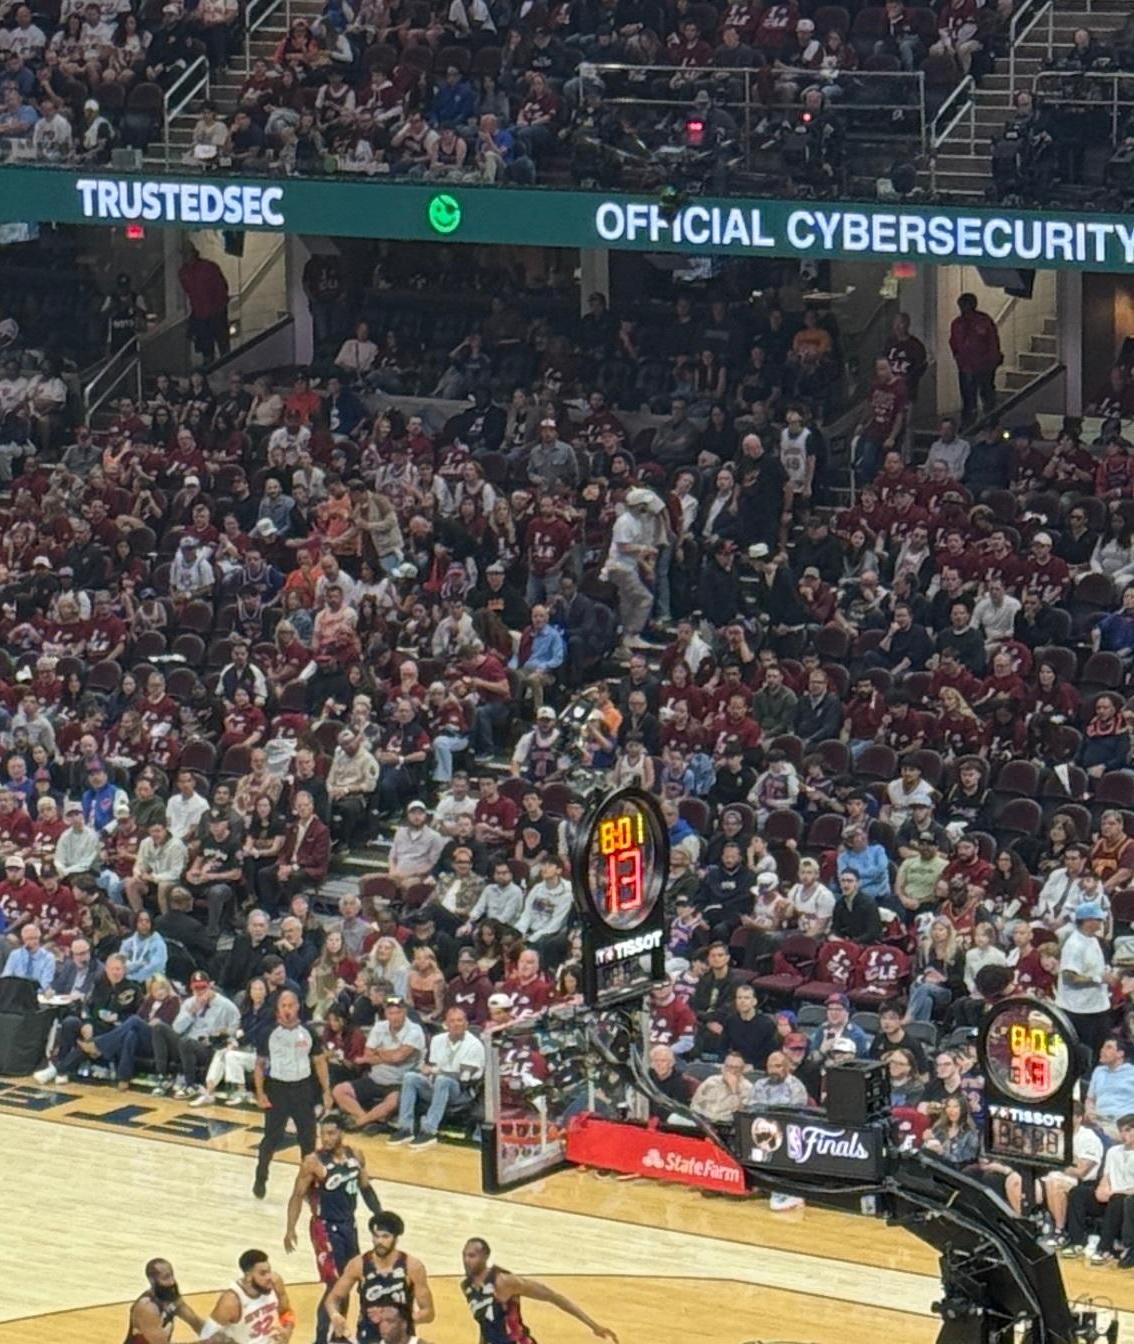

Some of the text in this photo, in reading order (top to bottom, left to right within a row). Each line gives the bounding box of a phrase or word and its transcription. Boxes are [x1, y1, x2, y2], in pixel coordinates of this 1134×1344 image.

[76, 178, 285, 226] TRUSTEDSEC
[787, 210, 1134, 264] CYBERSECURITY
[600, 812, 646, 856] 8:01
[606, 849, 645, 914] 13
[614, 929, 664, 960] TISSOT
[1009, 1108, 1065, 1129] TISSOT
[798, 1126, 869, 1164] Finals
[665, 1152, 740, 1184] StateFarm
